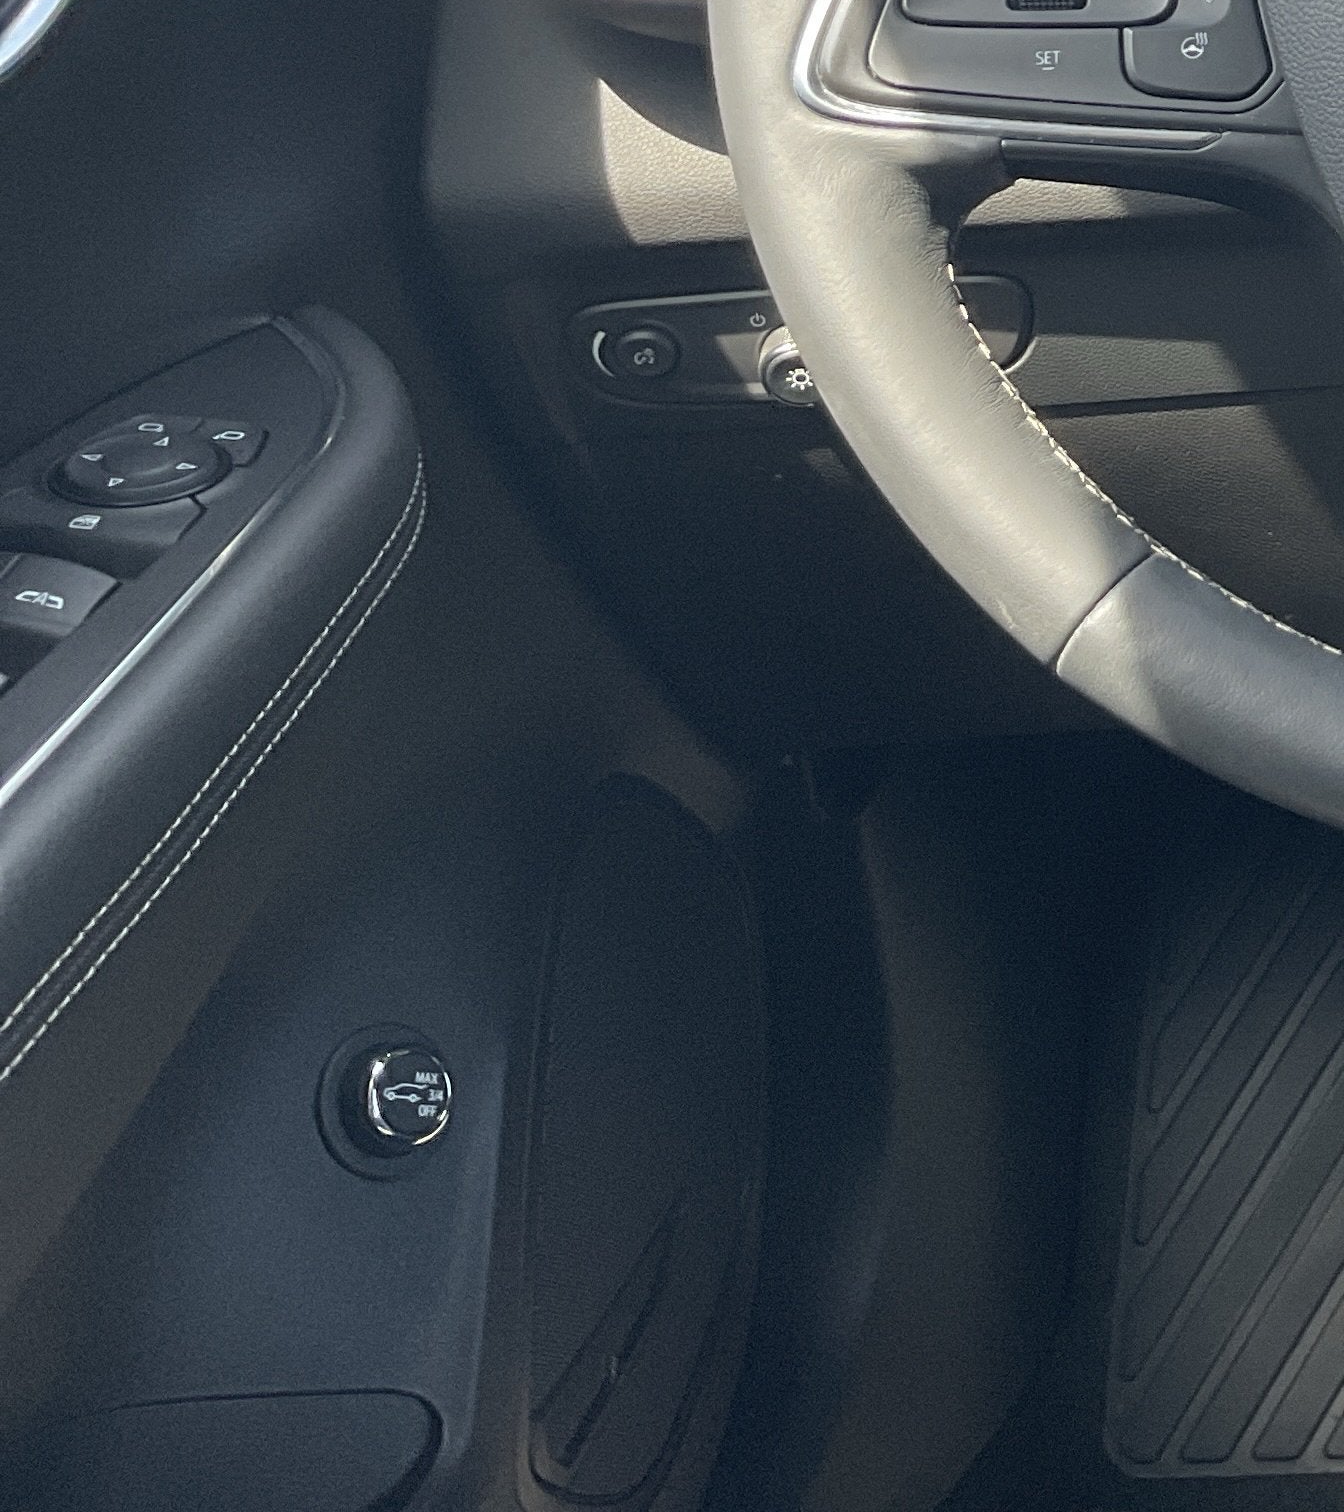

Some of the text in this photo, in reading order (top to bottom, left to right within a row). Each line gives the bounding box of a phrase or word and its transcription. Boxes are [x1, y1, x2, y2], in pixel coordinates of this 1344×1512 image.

[1035, 51, 1060, 65] SET
[415, 1071, 439, 1085] MAX
[417, 1104, 437, 1118] OFF
